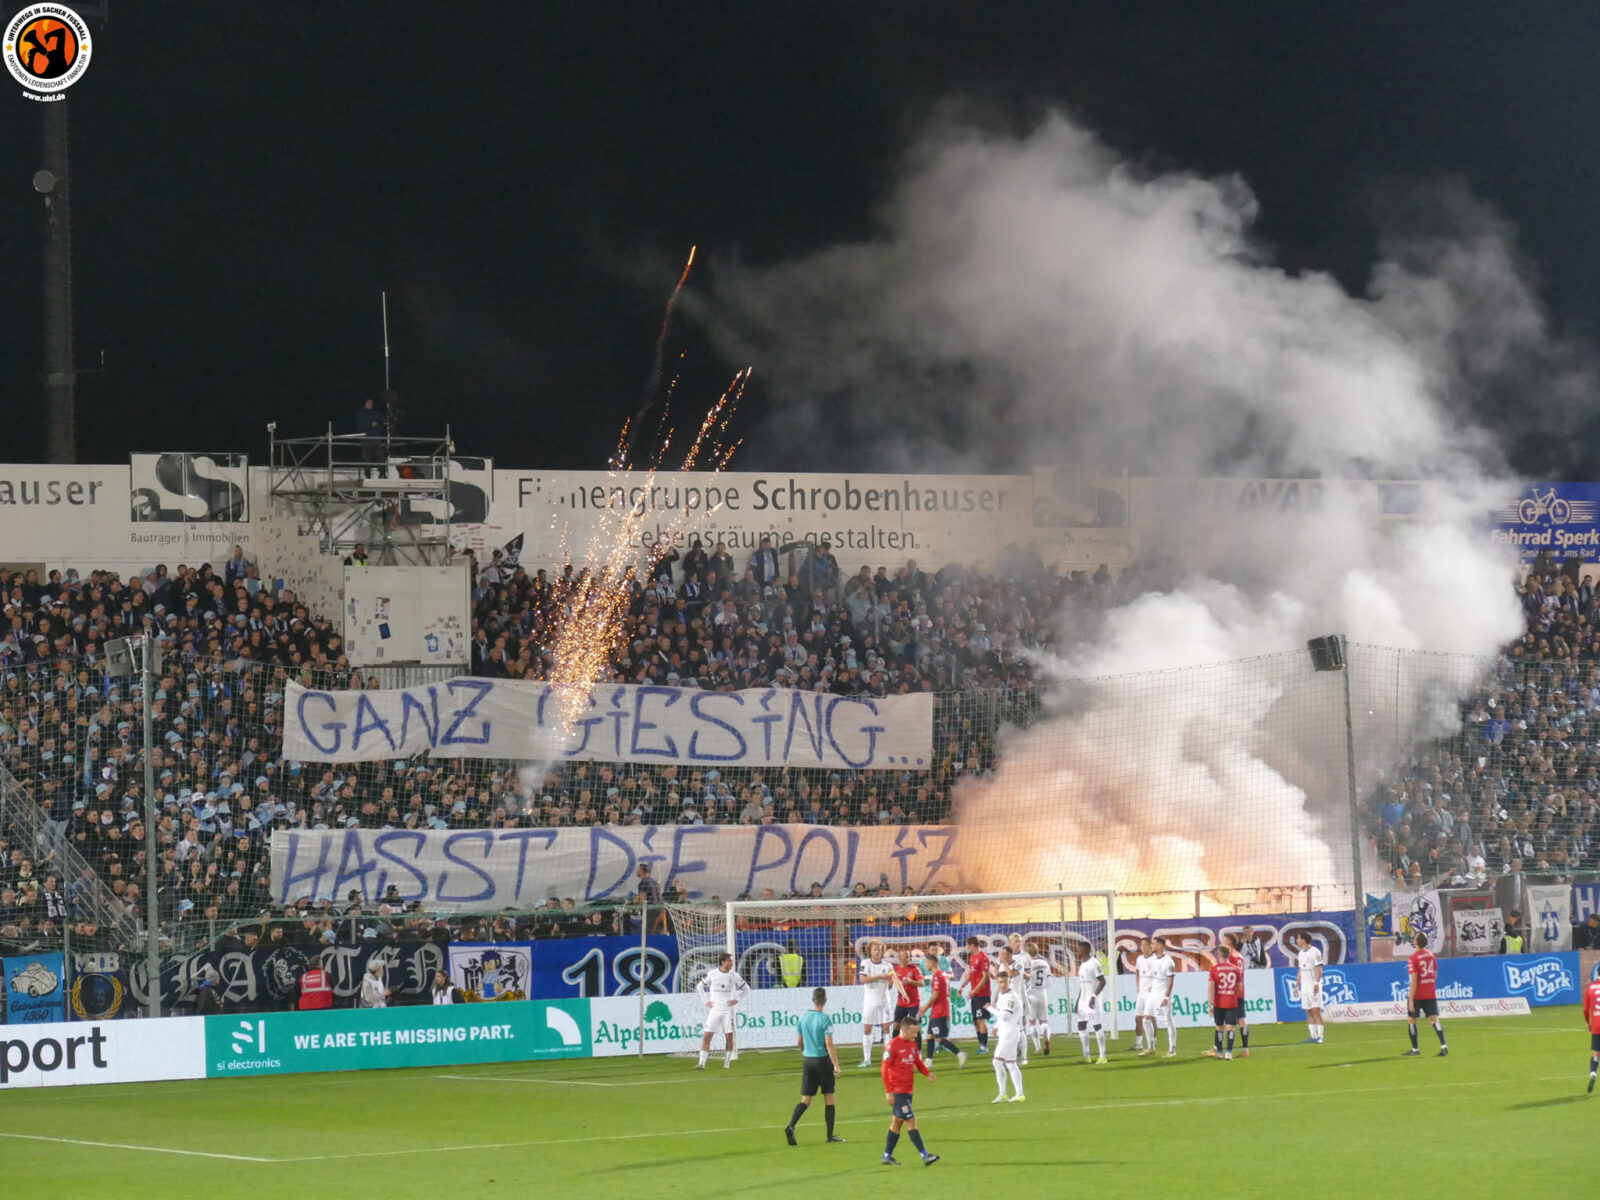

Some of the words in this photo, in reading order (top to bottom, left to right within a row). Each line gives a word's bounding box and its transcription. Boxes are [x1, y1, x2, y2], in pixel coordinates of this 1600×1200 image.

[752, 478, 1009, 513] Schrobenhauser
[192, 532, 250, 543] Immobilien
[1493, 528, 1552, 545] Fahrrad
[297, 680, 494, 755] GANZ
[281, 827, 558, 905] HASST
[585, 826, 717, 903] DIE
[746, 825, 962, 900] POLIZ
[1034, 969, 1043, 987] 5
[1218, 971, 1237, 989] 39
[1419, 960, 1435, 980] 34
[1507, 962, 1561, 989] Bayern
[736, 1012, 766, 1029] Das
[294, 1034, 320, 1049] WE
[324, 1032, 357, 1048] ARE
[360, 1030, 392, 1046] THE
[396, 1027, 467, 1044] MISSING
[470, 1024, 515, 1041] PART.
[594, 1014, 704, 1050] Alpenbaue
[0, 1026, 108, 1083] port
[228, 1058, 281, 1070] electronics
